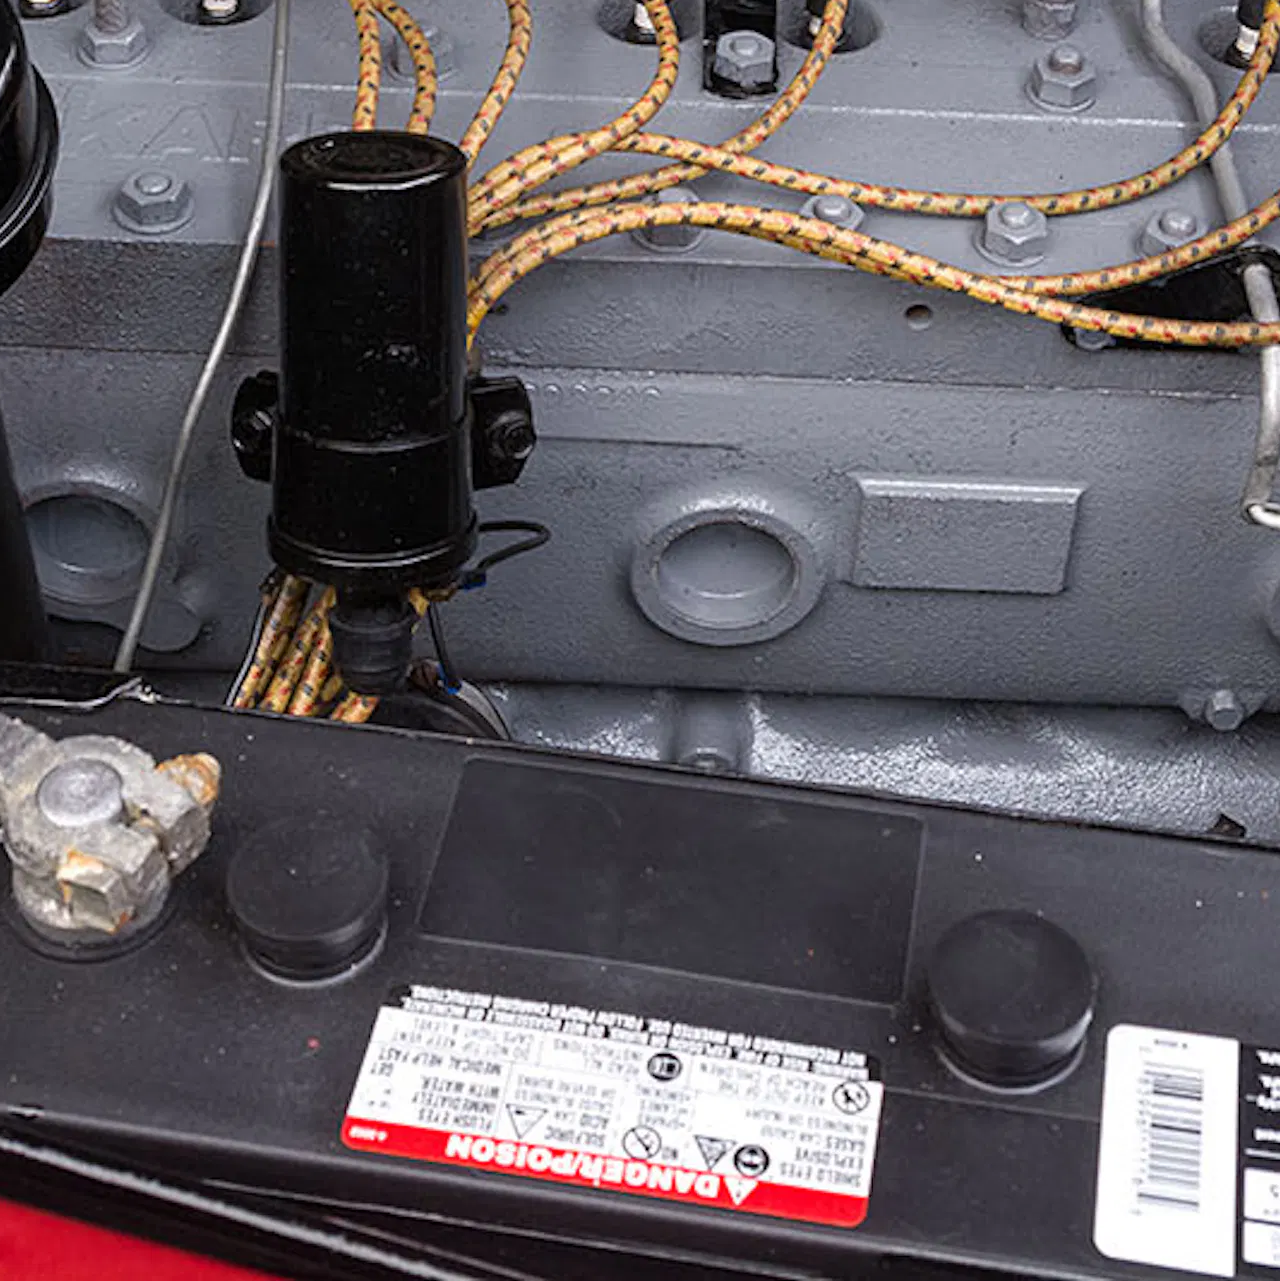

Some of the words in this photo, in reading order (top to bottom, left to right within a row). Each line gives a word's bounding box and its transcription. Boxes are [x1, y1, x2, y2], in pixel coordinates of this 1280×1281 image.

[410, 1052, 443, 1066] HELP
[446, 1057, 503, 1075] MEDICAL
[467, 1083, 501, 1098] WITH
[410, 1091, 497, 1114] IMMEDIATELY
[450, 1114, 492, 1130] FLUSH
[578, 1115, 608, 1128] ACID
[543, 1127, 605, 1147] SULFURIC
[442, 1132, 721, 1199] DANGER/POISON
[794, 1148, 863, 1170] EXPLOSIVE
[816, 1169, 861, 1188] SHIELD
